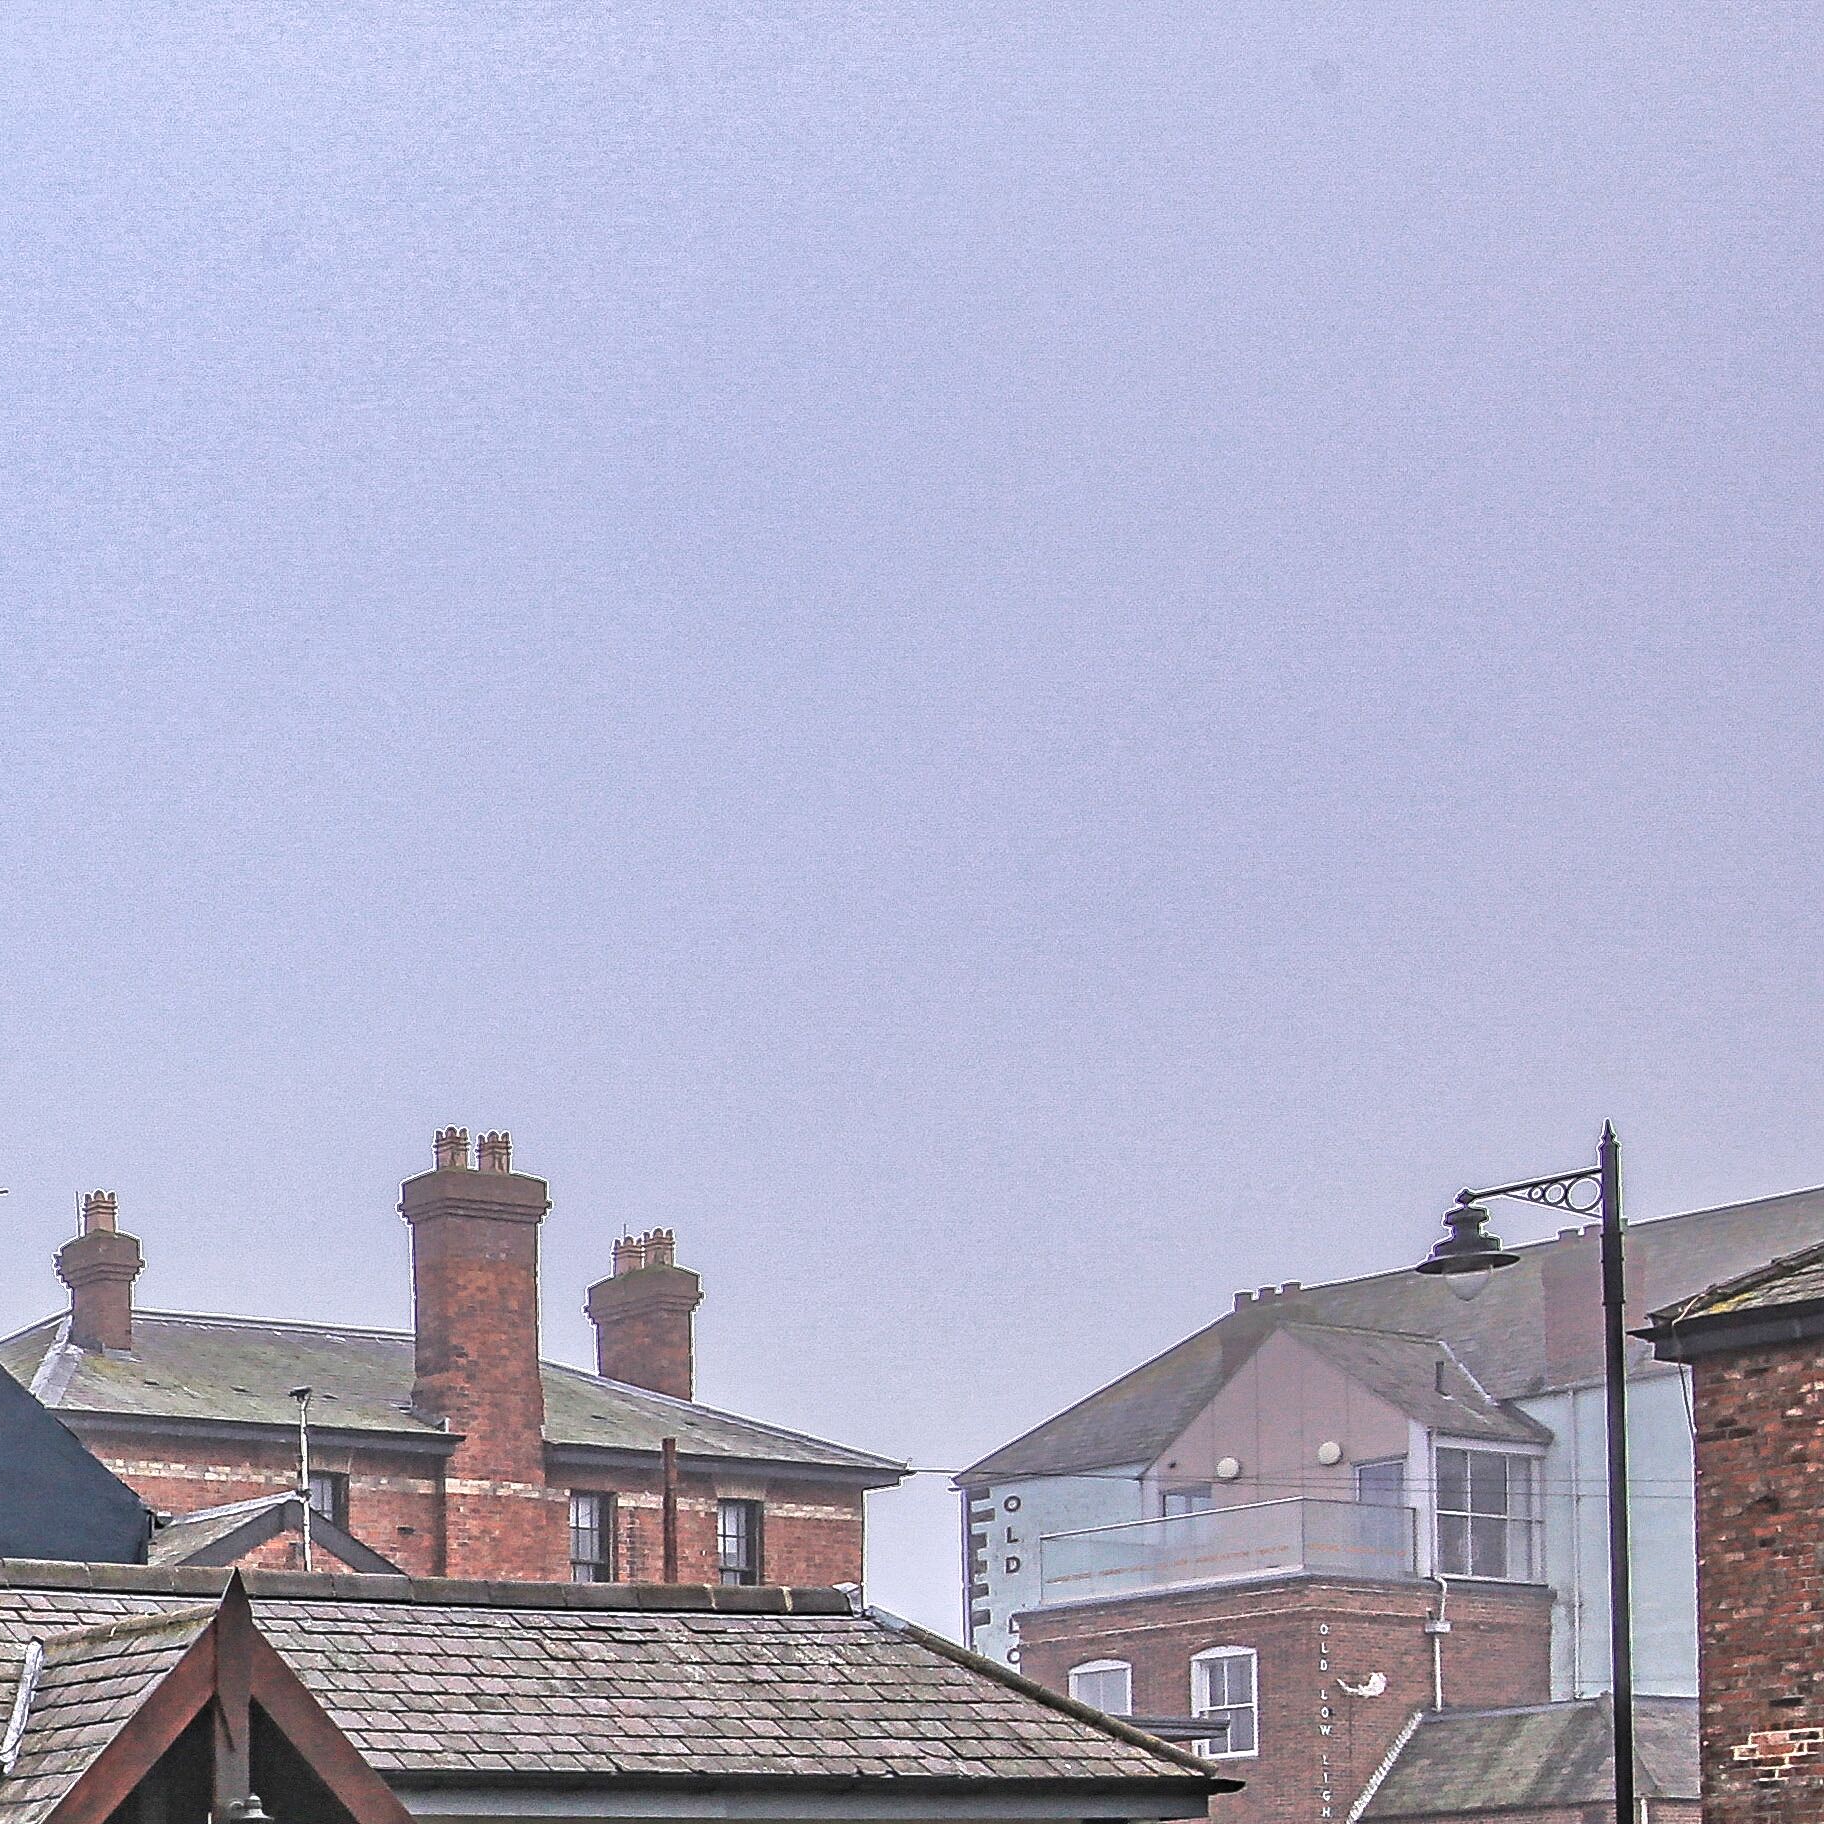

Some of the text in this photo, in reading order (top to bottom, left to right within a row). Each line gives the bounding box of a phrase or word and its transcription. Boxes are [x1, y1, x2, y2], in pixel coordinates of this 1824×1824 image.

[1004, 1495, 1022, 1665] OLD LO
[1319, 1623, 1329, 1671] OLD
[1319, 1689, 1331, 1736] LOW
